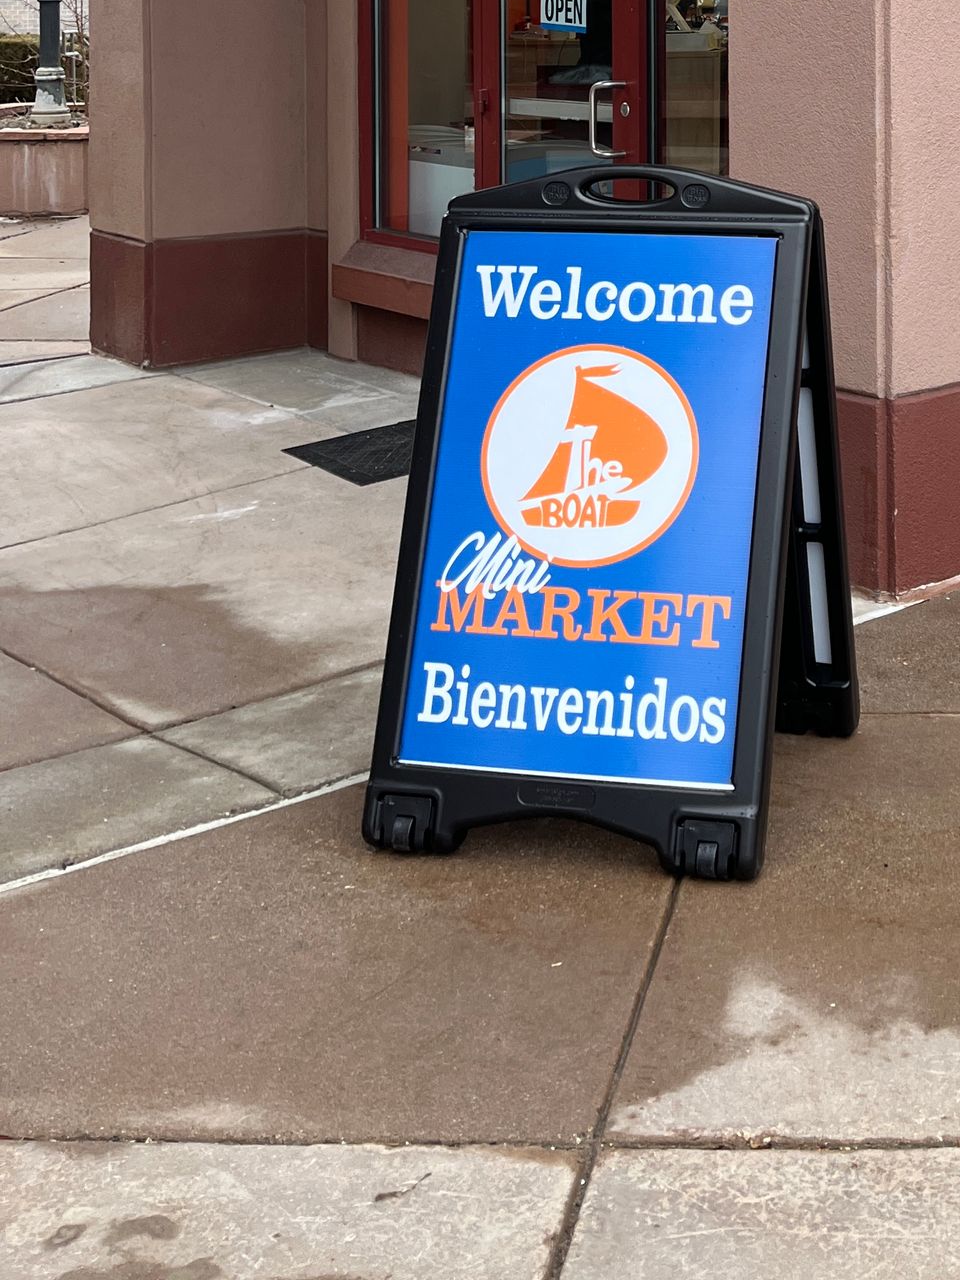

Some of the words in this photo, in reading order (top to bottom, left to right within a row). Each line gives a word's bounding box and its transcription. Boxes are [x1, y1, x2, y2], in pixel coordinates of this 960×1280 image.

[476, 264, 754, 325] Welcome
[561, 424, 623, 494] The
[541, 497, 611, 529] BOAT
[440, 531, 552, 599] Mini
[430, 580, 731, 650] MARKET
[417, 662, 727, 745] Bienvenidos
